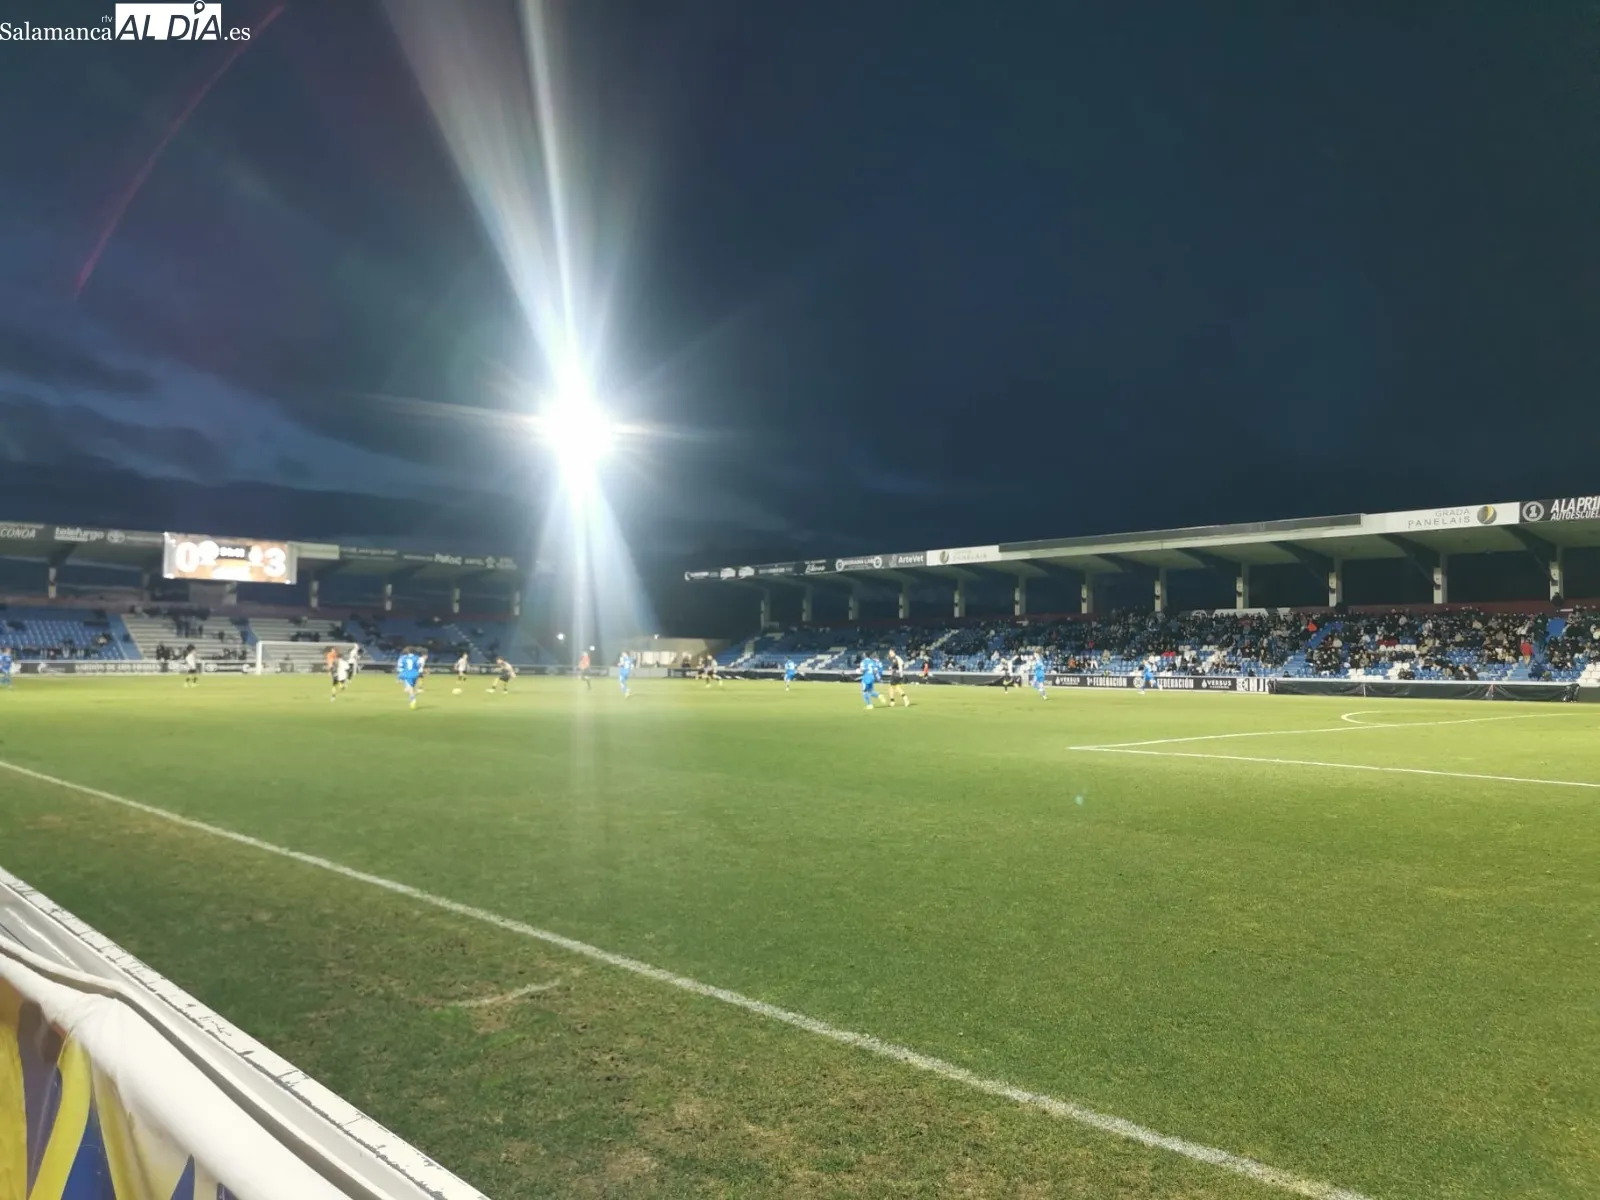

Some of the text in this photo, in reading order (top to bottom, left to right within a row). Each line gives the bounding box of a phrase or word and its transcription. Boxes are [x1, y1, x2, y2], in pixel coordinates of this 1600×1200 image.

[1434, 507, 1470, 518] GRADA
[1407, 516, 1471, 529] PANELAIS
[264, 547, 286, 577] 3
[898, 555, 924, 564] ArteVet
